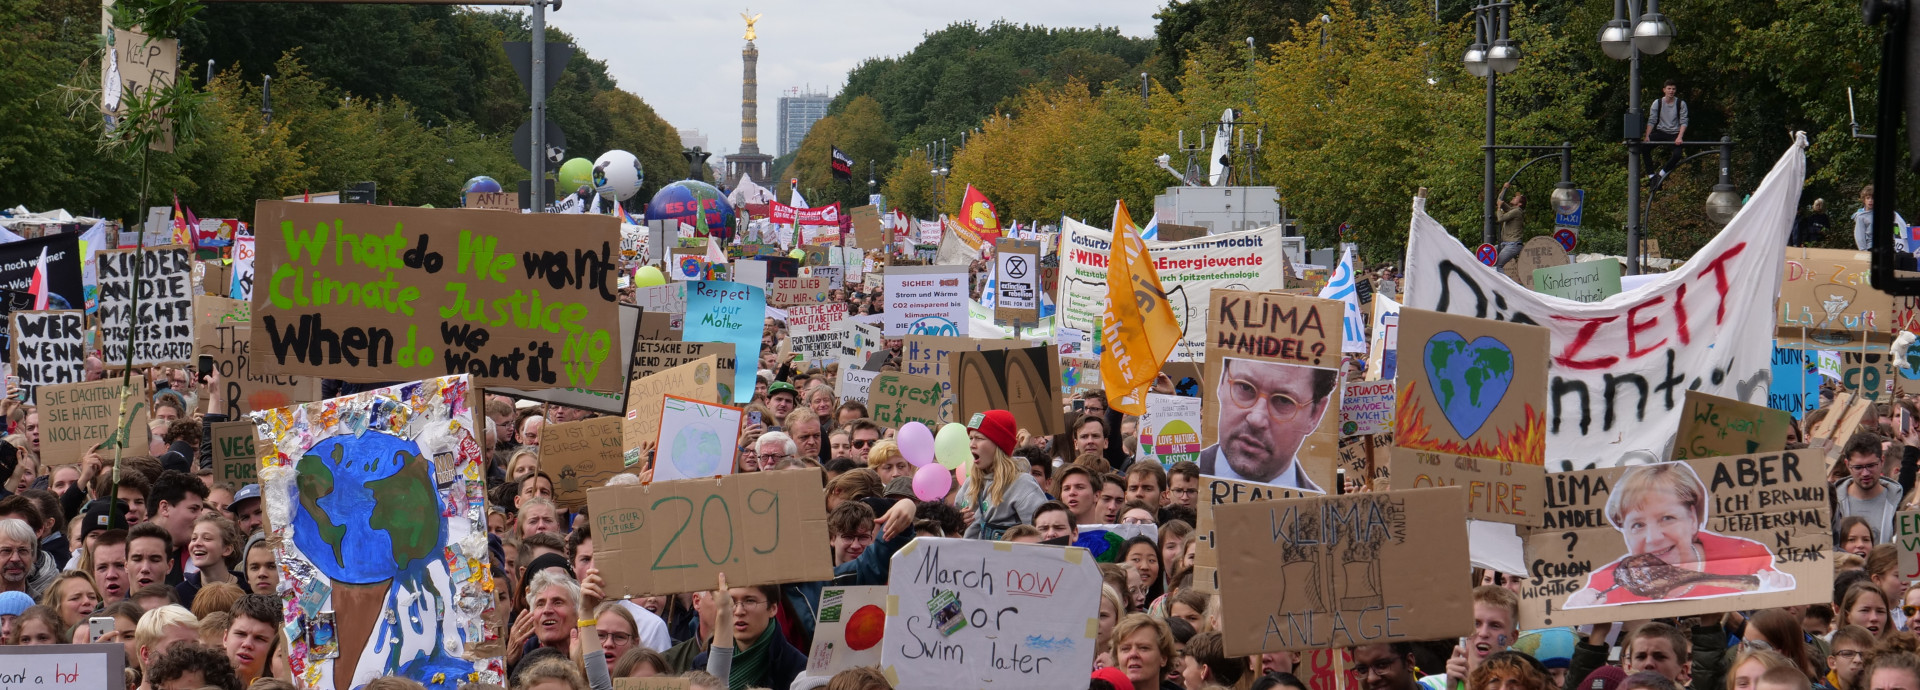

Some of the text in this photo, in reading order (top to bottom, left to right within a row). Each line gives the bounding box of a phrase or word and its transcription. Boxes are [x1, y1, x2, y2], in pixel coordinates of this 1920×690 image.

[665, 201, 684, 214] ES
[1559, 212, 1579, 224] TAXI
[281, 218, 616, 302] What do We want
[1524, 246, 1553, 257] THERE
[5, 258, 28, 272] noch
[1787, 261, 1871, 286] Die Zeit
[9, 279, 32, 291] Welt
[778, 279, 820, 289] SEID LIEB
[1001, 282, 1028, 290] extinction
[1179, 270, 1260, 282] Spitzentechnologie
[1542, 267, 1599, 290] Kindermund
[137, 276, 185, 301] DIE
[268, 262, 589, 334] Climate Justice
[650, 285, 677, 308] FÜR
[697, 281, 750, 303] Respect
[775, 292, 788, 302] ZU
[1008, 290, 1033, 298] rebellion
[713, 305, 741, 320] your
[789, 302, 848, 316] HEAL THE WORLD
[909, 301, 949, 309] einsparend
[1549, 242, 1747, 370] ZEIT
[17, 314, 82, 340] WER
[701, 312, 743, 330] Mother
[790, 315, 807, 326] MAKE
[820, 312, 842, 323] BETTER
[808, 323, 831, 332] PLACE
[165, 324, 189, 341] IN
[263, 313, 490, 369] When do we
[792, 331, 838, 344] FOR YOU AND FOR
[18, 341, 83, 363] WENN
[527, 340, 556, 385] it
[561, 329, 612, 364] NO
[687, 344, 703, 355] IST
[792, 341, 832, 353] AND THE ENTIRE
[1217, 331, 1327, 365] WANDEL?
[17, 363, 86, 384] NICHT
[664, 359, 678, 368] ZU
[908, 363, 930, 375] but
[565, 360, 599, 388] W
[45, 386, 115, 406] SIE DACHTEN
[227, 381, 242, 421] B
[49, 409, 69, 422] SIE
[664, 397, 738, 424] SAVE
[1694, 402, 1766, 436] We want
[48, 424, 109, 443] NOCH ZEIT
[541, 421, 613, 442] ES IST DIE
[1158, 433, 1196, 445] LOVE NATURE
[543, 440, 591, 456] EURER
[1171, 444, 1187, 453] HATE
[1165, 453, 1193, 465] FASCISM
[1416, 453, 1513, 476] THIS GIRL IS
[1710, 452, 1803, 494] ABER
[1468, 480, 1527, 517] FIRE
[1758, 486, 1824, 509] BRAUCH
[600, 512, 640, 525] IT'S OUR
[603, 522, 636, 534] FUTURE
[1270, 500, 1392, 546] KLIMA
[1392, 498, 1406, 546] WANDEL
[1562, 531, 1579, 560] ?
[1775, 544, 1826, 563] STEAK
[914, 545, 1064, 595] March now
[1522, 579, 1580, 600] WICHTIG
[970, 606, 1019, 631] or
[1262, 605, 1406, 651] ANLAGE
[901, 615, 1053, 675] Swim later
[35, 663, 80, 685] a hot
